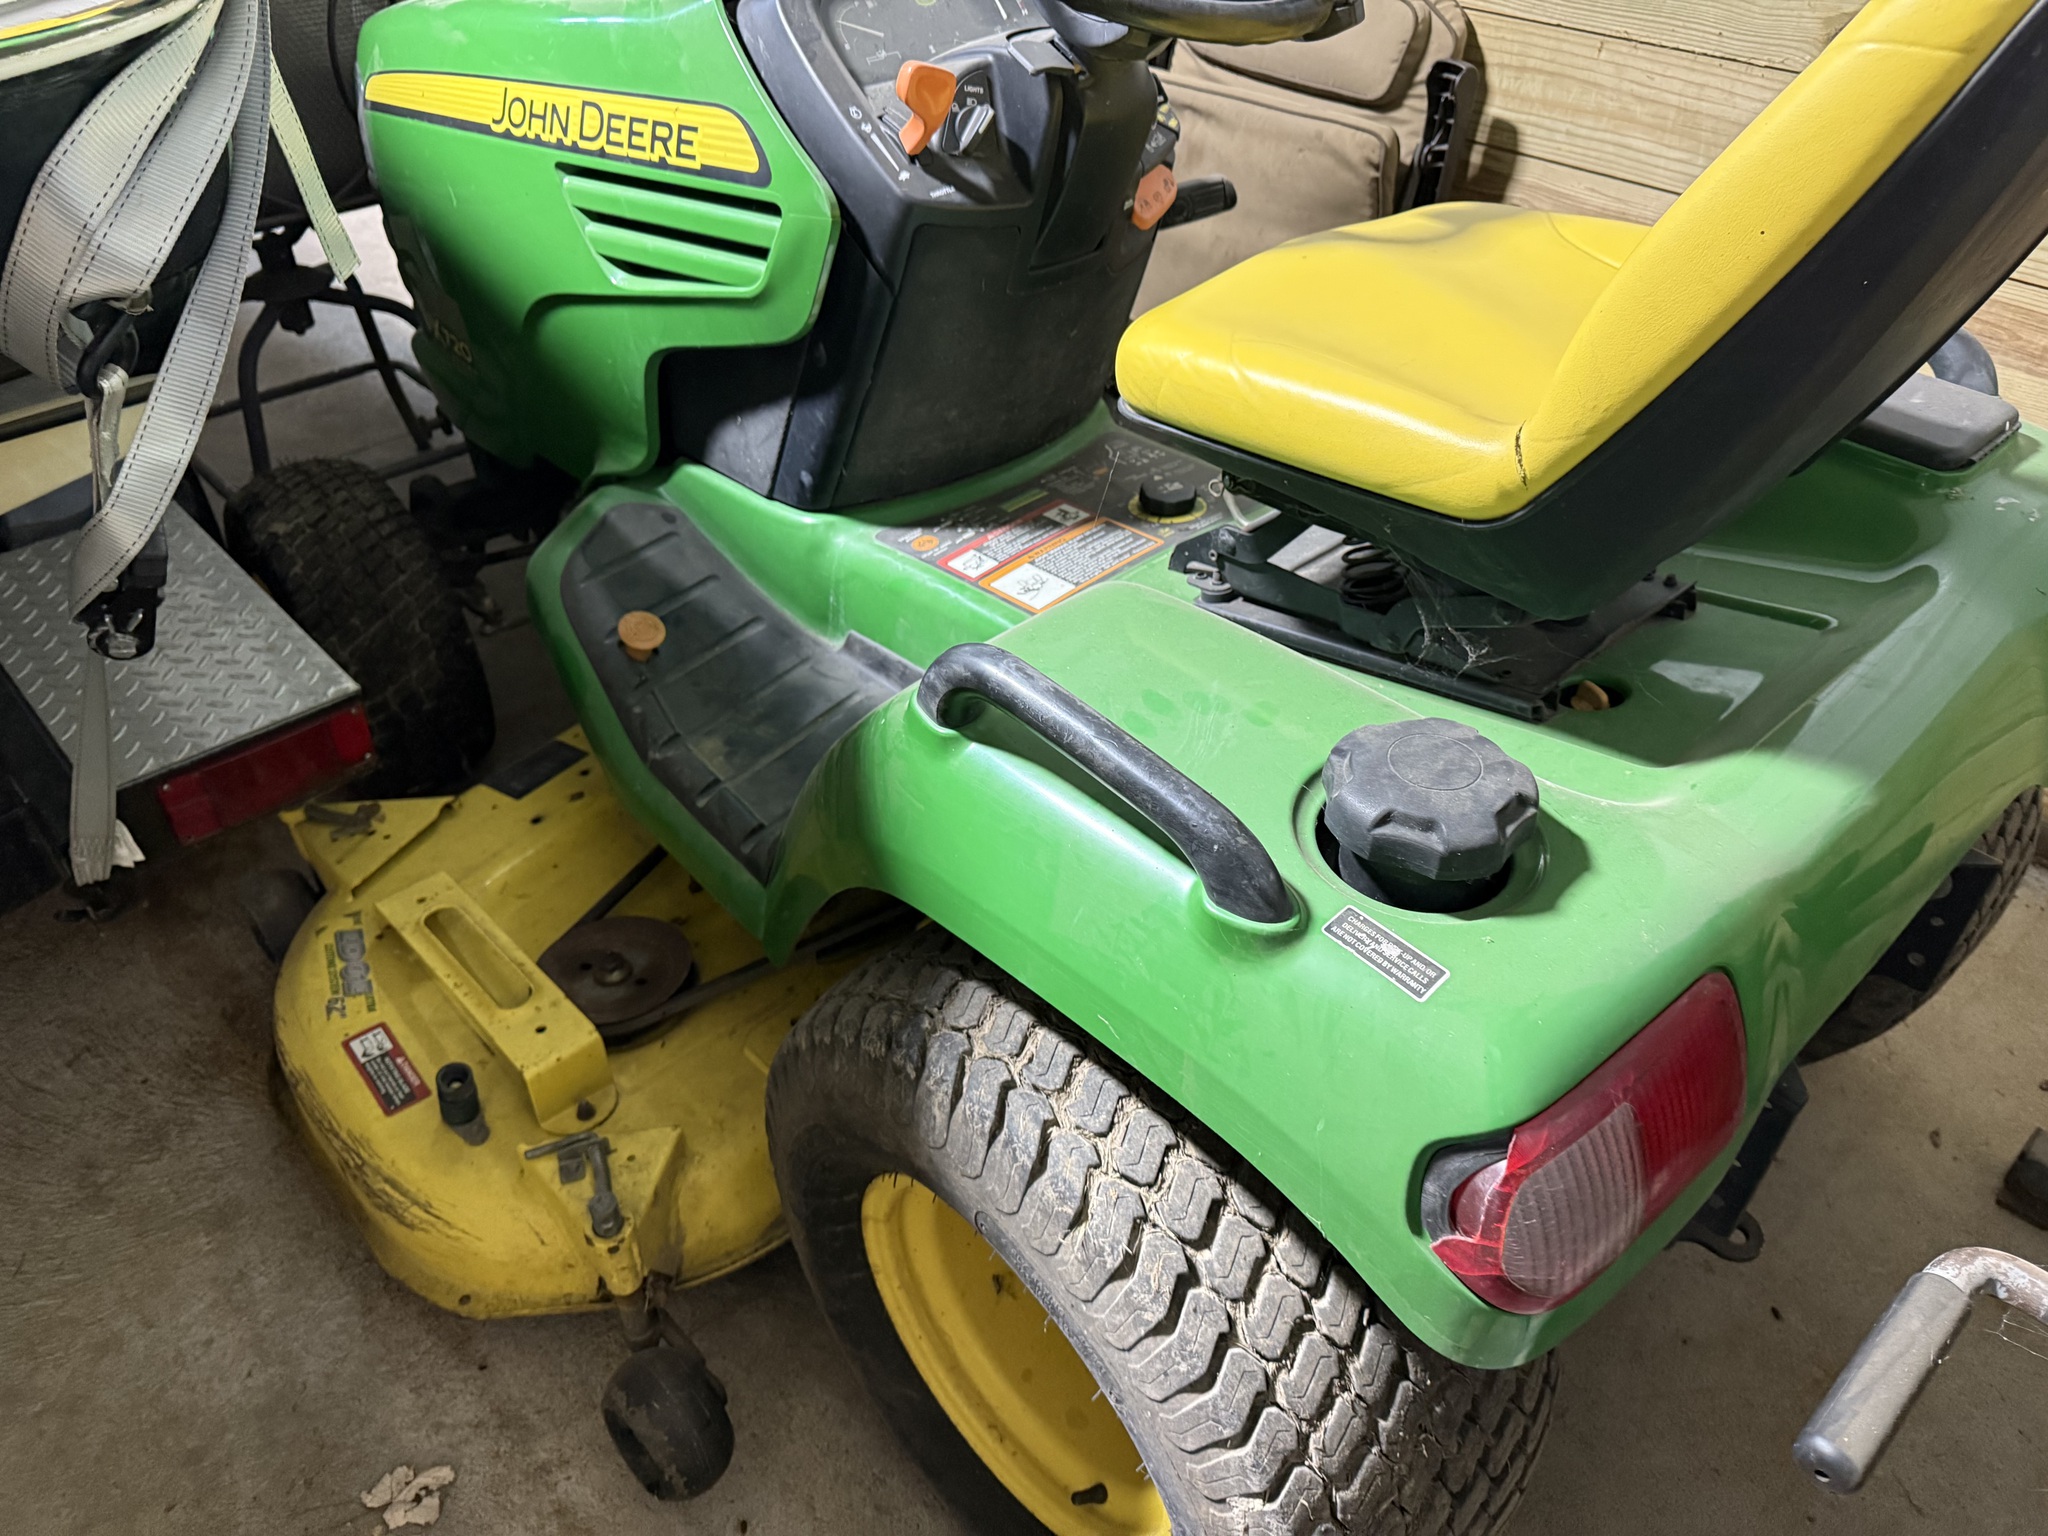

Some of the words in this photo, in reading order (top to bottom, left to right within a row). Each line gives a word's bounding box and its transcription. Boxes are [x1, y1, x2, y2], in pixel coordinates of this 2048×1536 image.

[964, 84, 984, 95] LIGHTS
[492, 87, 570, 139] JOHN
[579, 100, 699, 161] DEERE
[1331, 926, 1344, 937] ARE
[1343, 934, 1356, 946] NOT
[1355, 942, 1384, 964] COVERED
[1382, 961, 1392, 972] BY
[1390, 966, 1426, 994] WARRANTY
[1342, 923, 1371, 945] DELIVERY
[1369, 941, 1383, 952] AND
[1381, 948, 1408, 971] SERVICE
[1407, 967, 1429, 984] CALLS
[1348, 916, 1376, 936] CHARGES
[1375, 933, 1388, 946] FOR
